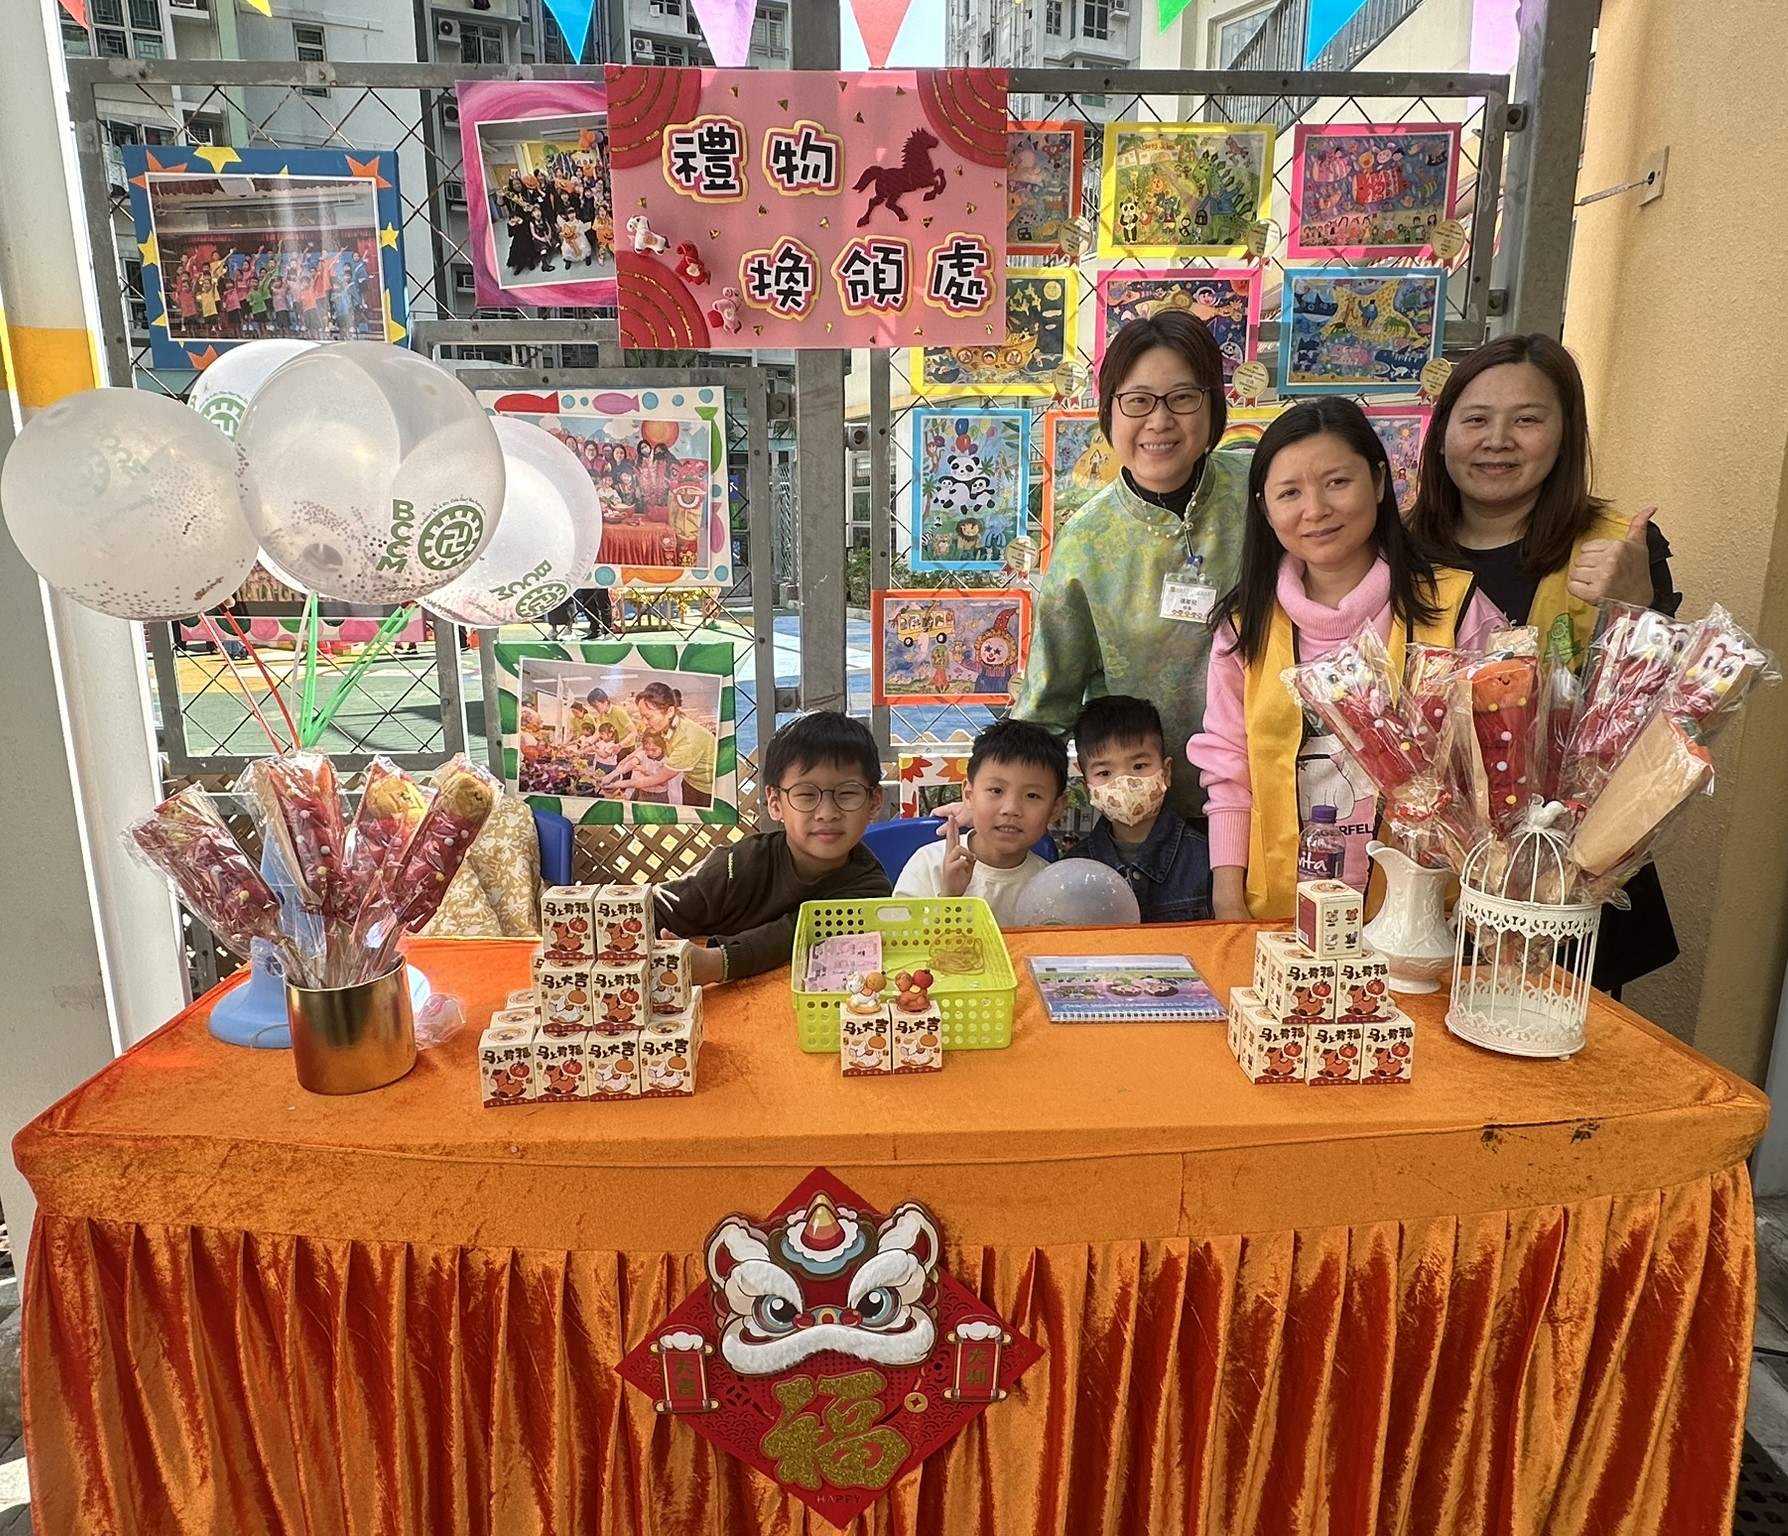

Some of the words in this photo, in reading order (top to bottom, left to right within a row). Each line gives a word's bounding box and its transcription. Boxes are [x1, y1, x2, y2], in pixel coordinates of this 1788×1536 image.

[673, 125, 834, 193] 禮物
[749, 242, 986, 308] 換領處
[375, 499, 416, 573] BCCM
[489, 560, 552, 601] BCCM
[541, 972, 589, 989] 马上大吉
[843, 1018, 889, 1035] 马上大吉
[895, 1016, 941, 1034] 马上大吉
[588, 1040, 636, 1058] 马上大吉
[641, 1038, 689, 1056] 马上大吉
[760, 1367, 911, 1490] 福
